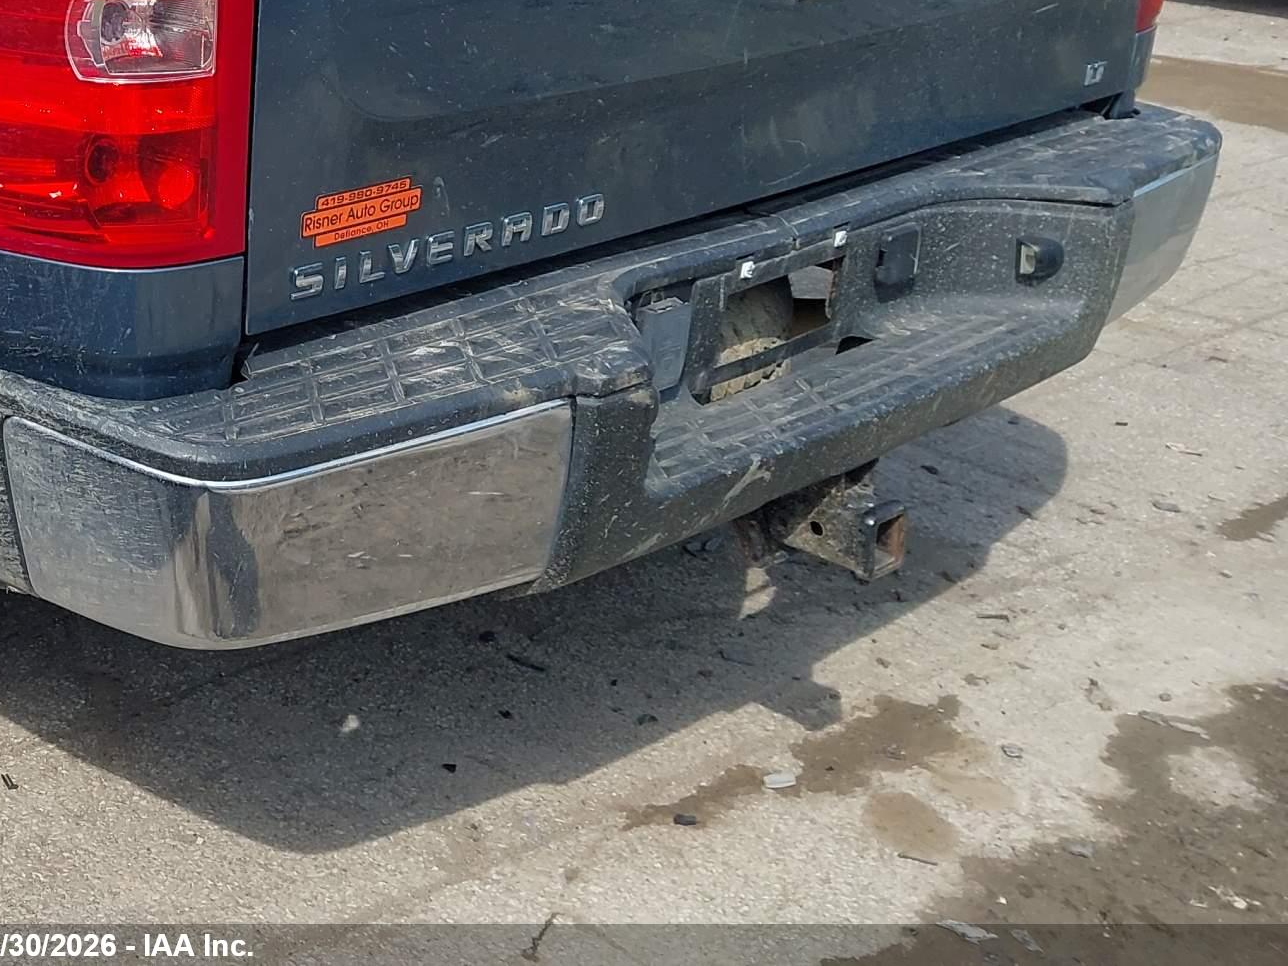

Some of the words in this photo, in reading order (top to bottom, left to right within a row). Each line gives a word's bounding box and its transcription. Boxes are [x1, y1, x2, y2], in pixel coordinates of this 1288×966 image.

[304, 213, 344, 232] Risner
[346, 203, 376, 223] Auto
[379, 194, 419, 214] Group
[376, 220, 390, 231] OH
[290, 193, 606, 301] SILVERADO
